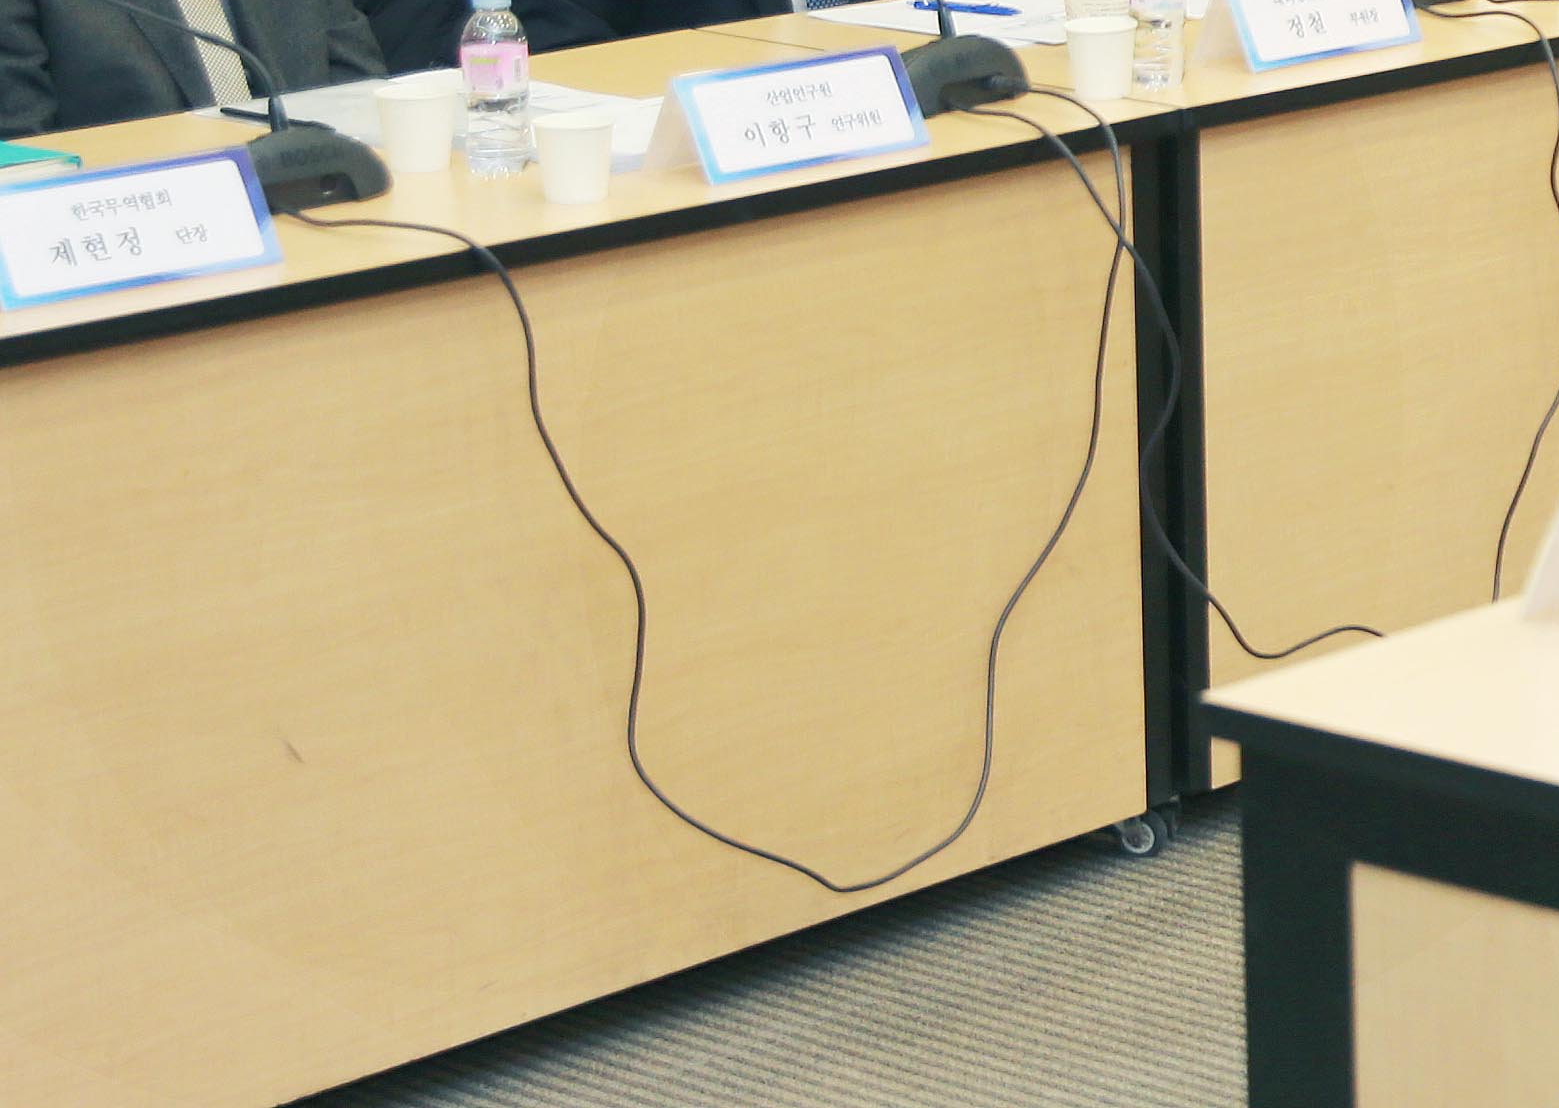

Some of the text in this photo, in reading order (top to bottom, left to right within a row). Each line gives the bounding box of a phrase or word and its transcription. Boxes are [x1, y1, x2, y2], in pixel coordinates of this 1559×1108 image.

[766, 81, 833, 106] 산업연구원
[744, 114, 816, 148] 이항구
[70, 188, 173, 222] 한국무역협회
[48, 223, 208, 268] 제현정 단장
